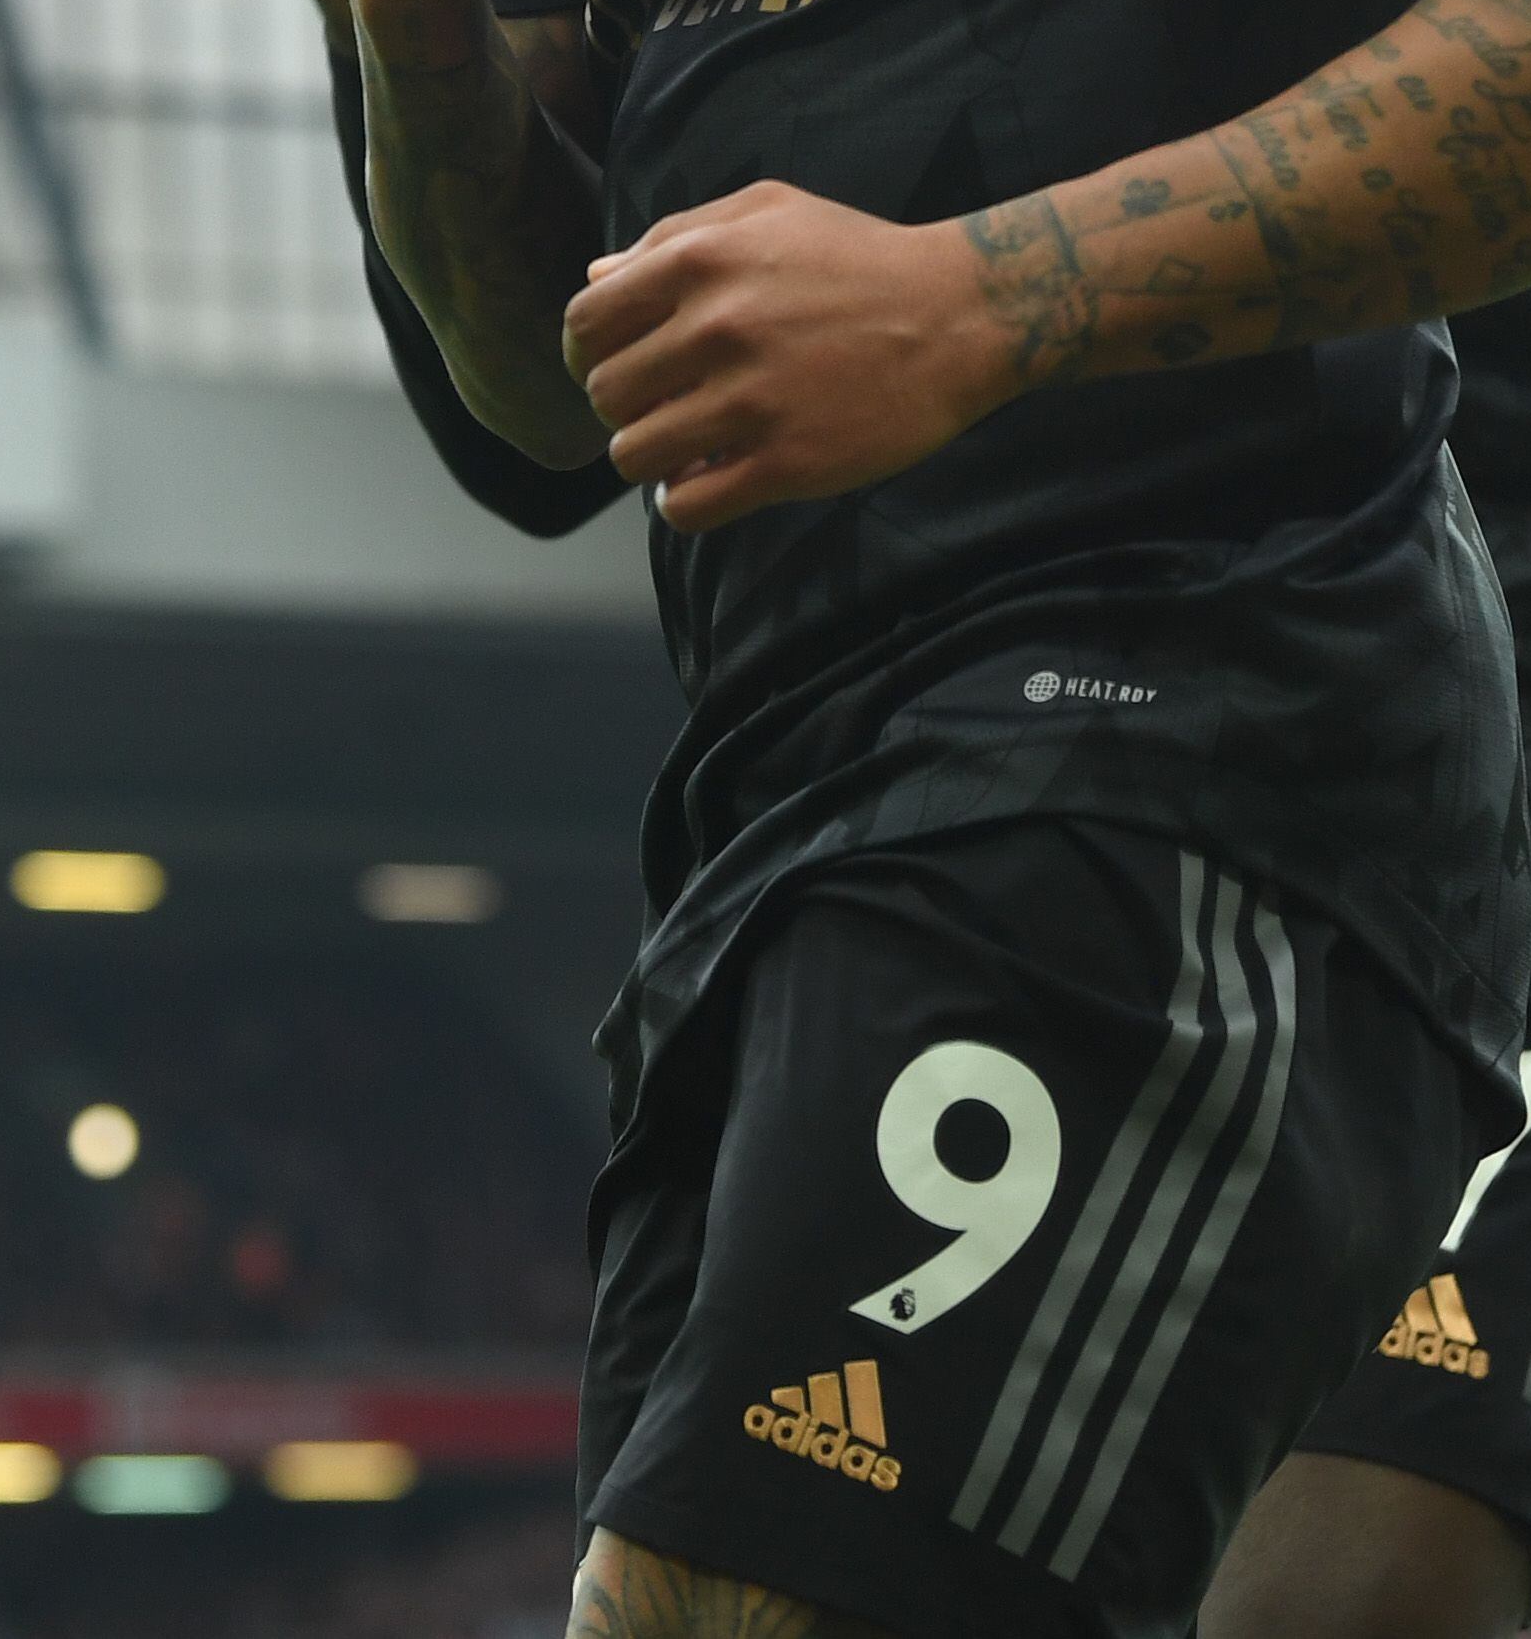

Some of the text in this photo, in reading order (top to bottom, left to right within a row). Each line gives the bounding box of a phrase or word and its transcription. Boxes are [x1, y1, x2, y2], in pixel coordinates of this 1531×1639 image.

[1064, 676, 1158, 703] HEAT.RDY
[848, 1040, 1061, 1335] 9
[1376, 1319, 1490, 1380] didas
[743, 1403, 902, 1492] adidas
